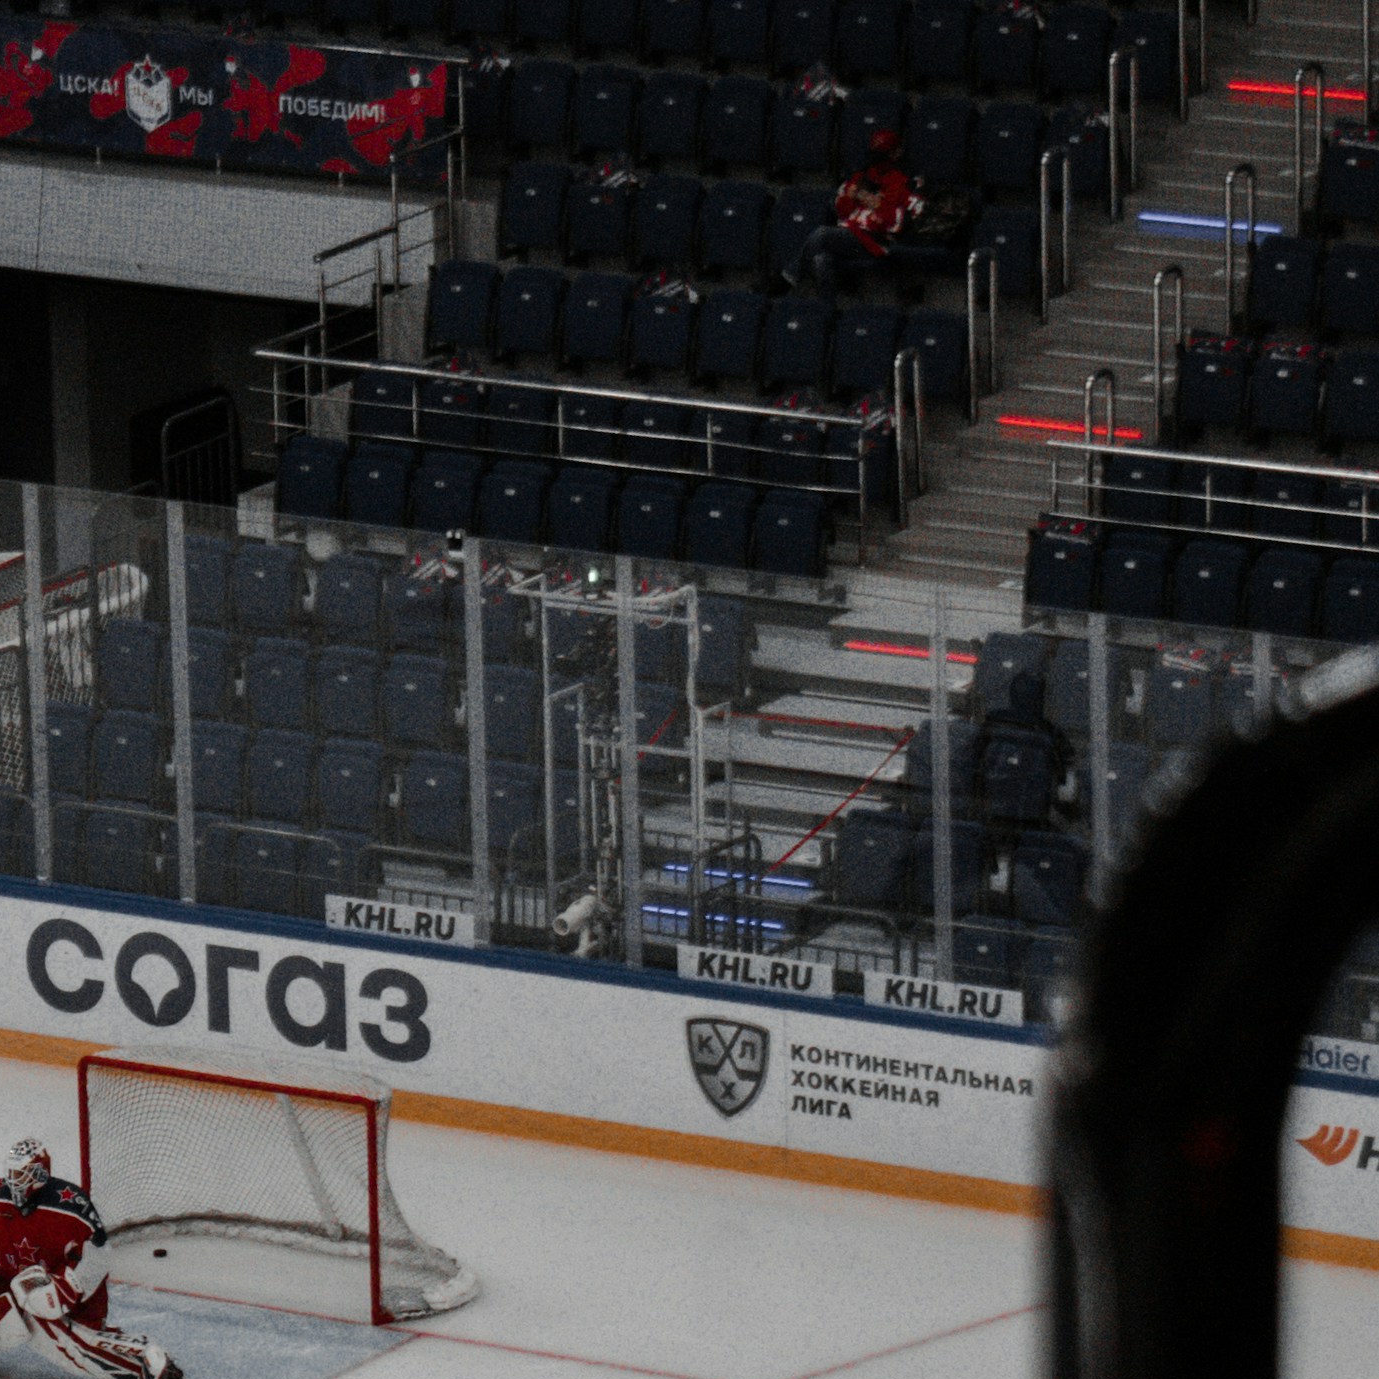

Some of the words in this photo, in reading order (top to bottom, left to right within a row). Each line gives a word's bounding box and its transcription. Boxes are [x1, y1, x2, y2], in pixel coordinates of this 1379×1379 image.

[58, 74, 119, 97] ЦСКА!
[178, 86, 214, 106] МЫ
[278, 96, 387, 123] ПОБЕДИМ!
[344, 901, 456, 941] KHL.RU
[696, 952, 813, 991] KHL.RU
[884, 978, 1003, 1019] KHL.RU
[790, 1043, 1033, 1096] КОНТИНЕНТАЛЬНАЯ
[791, 1070, 940, 1108] ХОККЕЙНАЯ
[791, 1095, 852, 1120] ЛИГА
